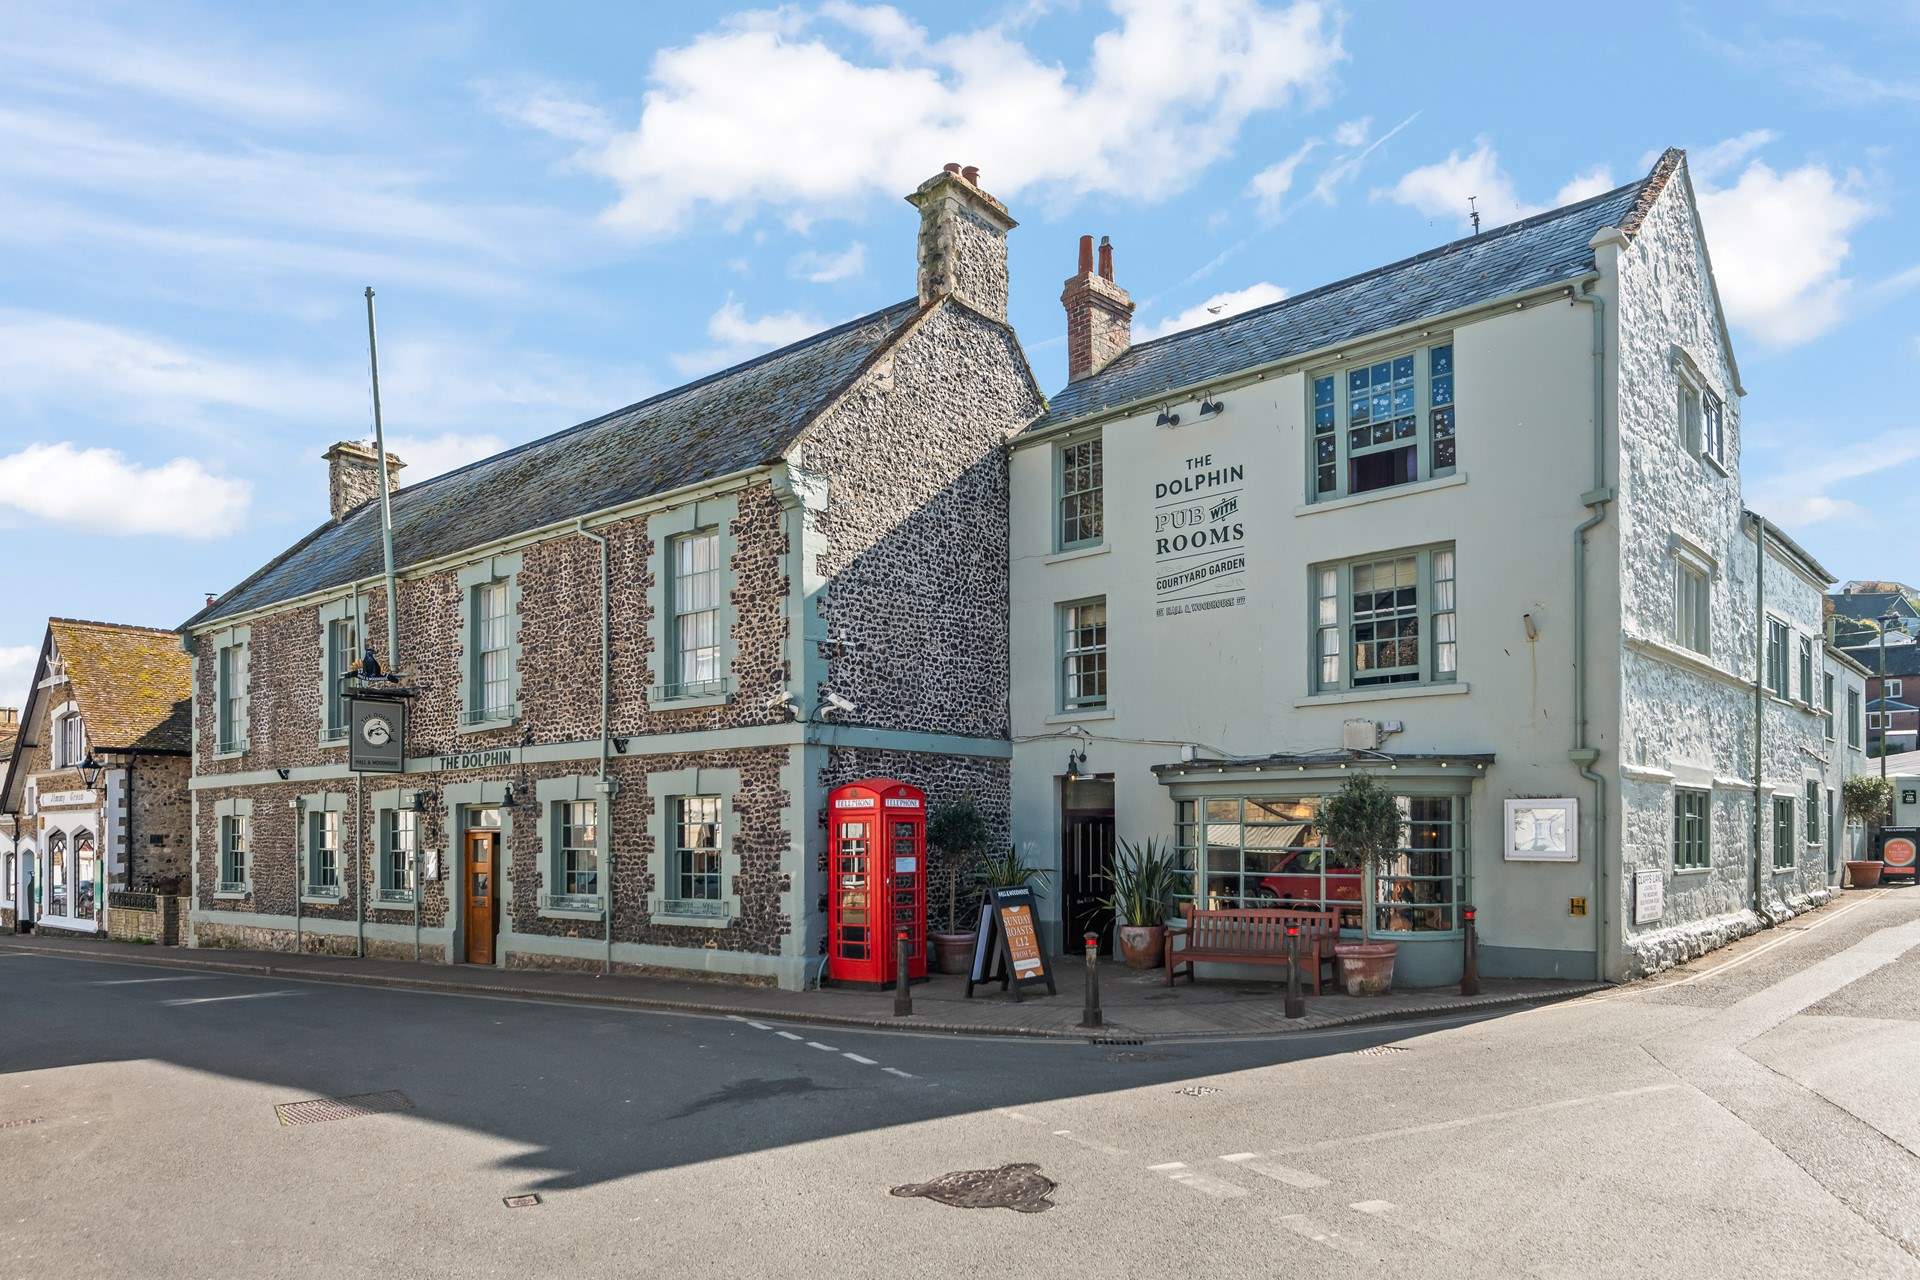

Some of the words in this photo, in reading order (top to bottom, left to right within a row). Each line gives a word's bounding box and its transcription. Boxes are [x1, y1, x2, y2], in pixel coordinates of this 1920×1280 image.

[1186, 454, 1212, 470] THE
[1155, 464, 1244, 499] DOLPHIN
[1155, 505, 1206, 533] PUB
[1210, 499, 1237, 521] WITH
[1156, 523, 1244, 555] ROOMS
[1156, 568, 1207, 590] COURTYARD
[1209, 558, 1245, 575] GARDEN
[440, 756, 460, 770] THE
[462, 750, 511, 768] DOLPHIN
[1004, 914, 1031, 927] SUNDAY
[1006, 926, 1033, 937] ROASTS
